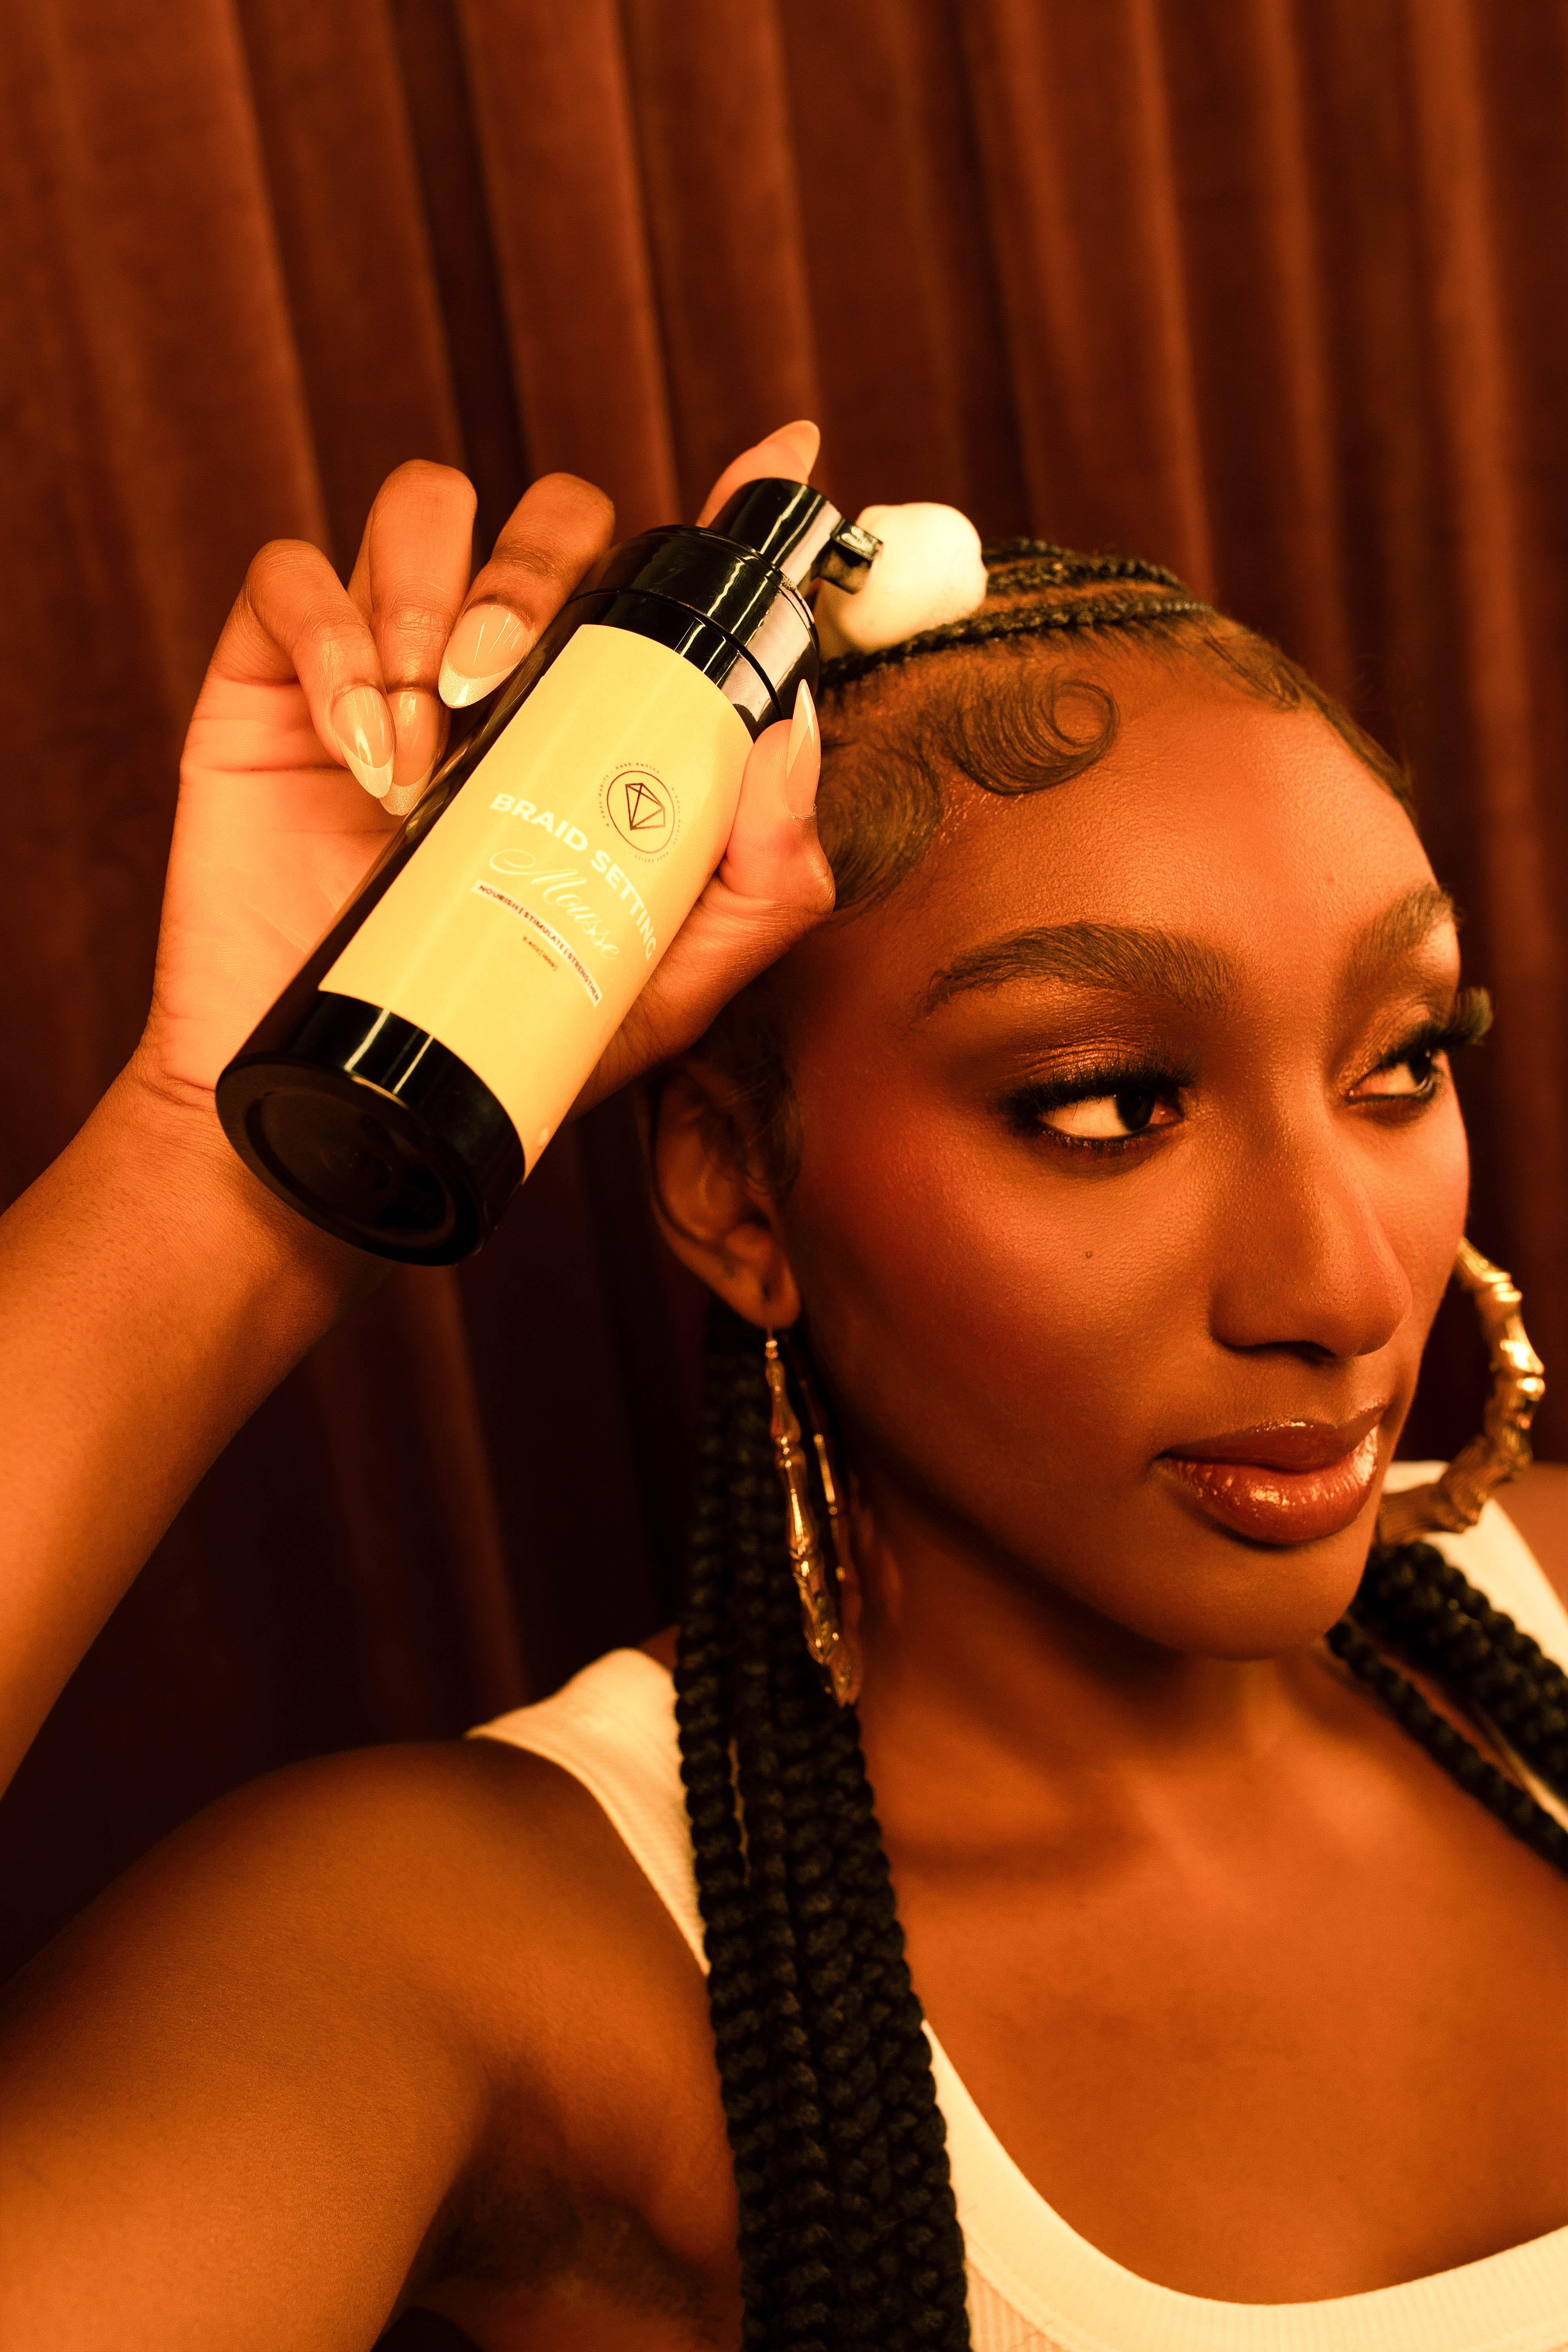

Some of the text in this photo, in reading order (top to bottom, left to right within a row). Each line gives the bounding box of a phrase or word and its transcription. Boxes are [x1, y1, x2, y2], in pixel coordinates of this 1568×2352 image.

[490, 793, 588, 851] BRAID
[590, 850, 656, 960] SETTING
[490, 849, 619, 959] Mousse
[479, 885, 519, 911] NOURISH
[524, 911, 564, 951] STIMULATE
[568, 953, 599, 1002] STRENGTHEN
